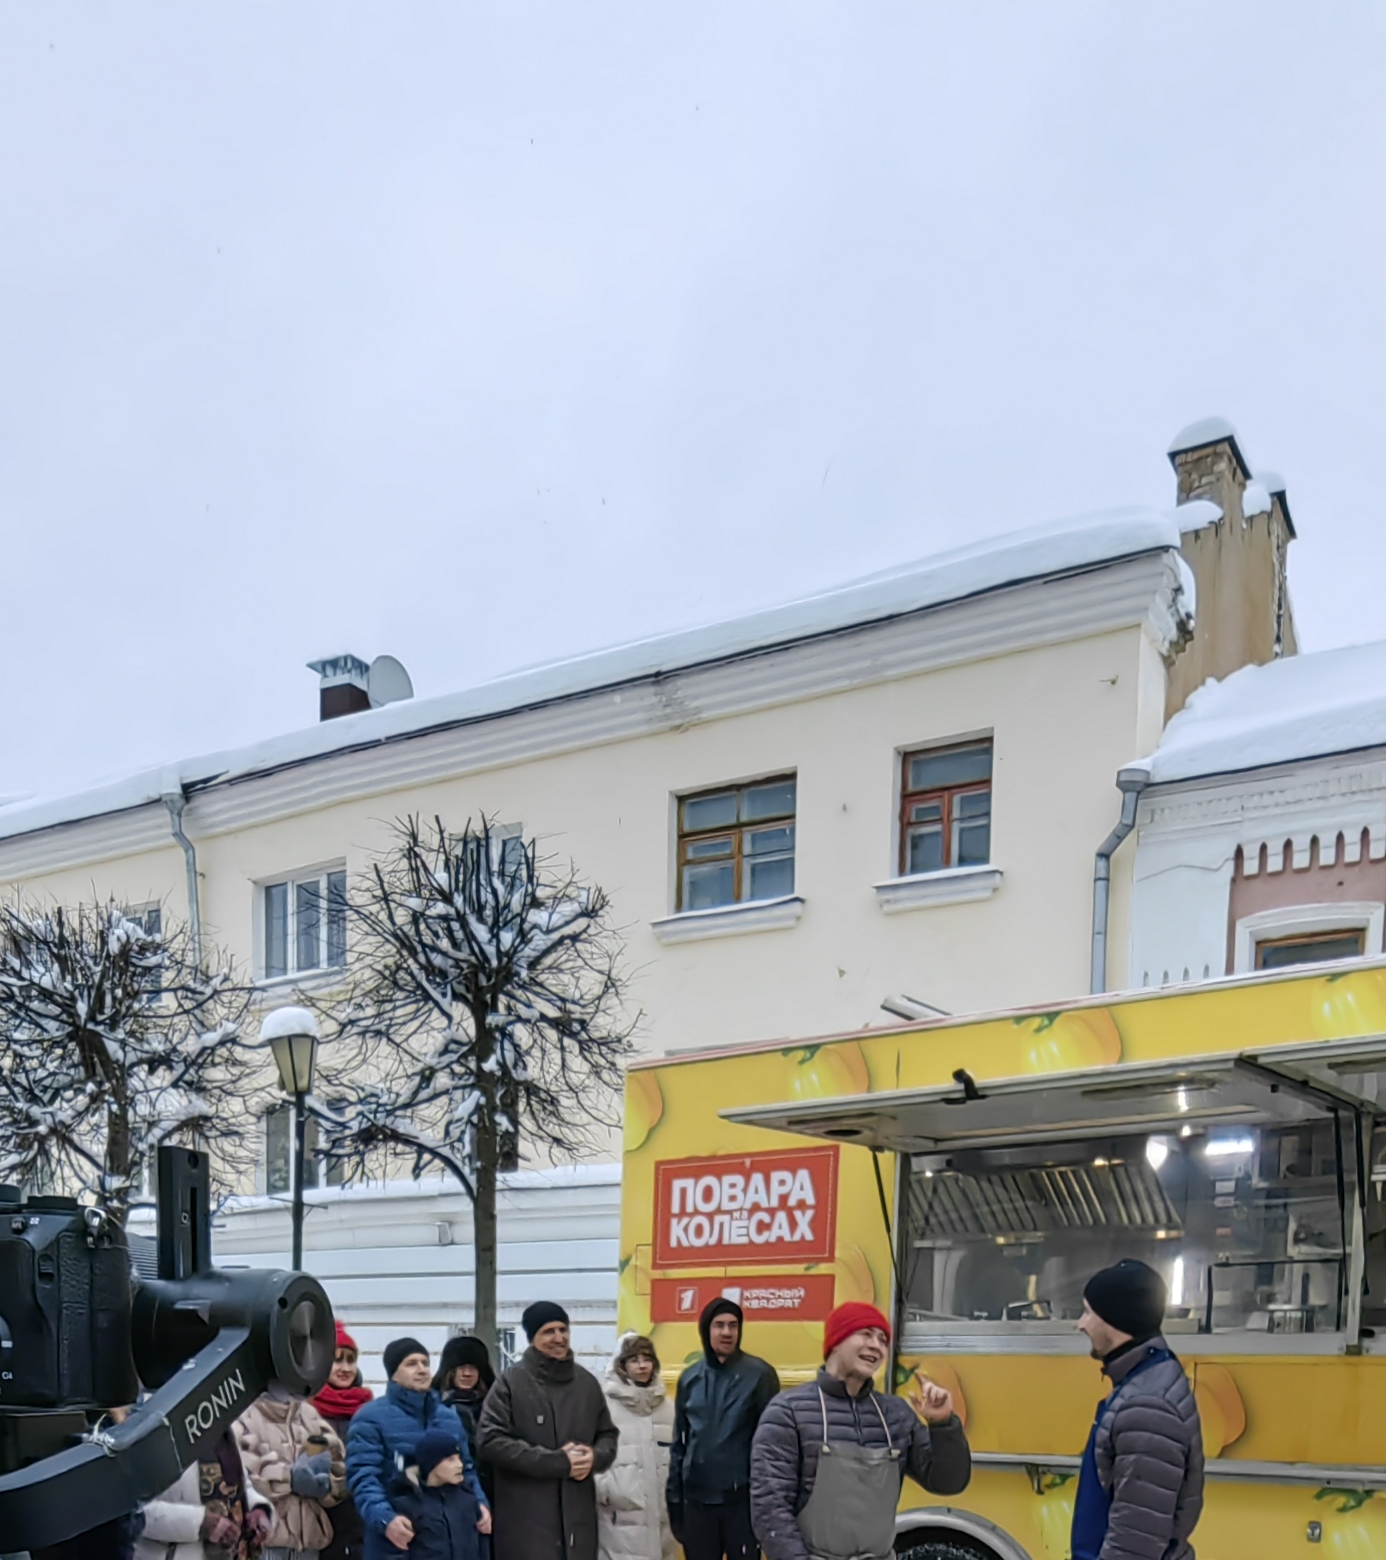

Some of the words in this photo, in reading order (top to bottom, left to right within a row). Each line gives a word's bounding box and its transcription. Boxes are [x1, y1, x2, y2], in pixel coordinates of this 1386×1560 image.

[671, 1169, 816, 1214] ПОВАРА
[669, 1209, 815, 1248] КОЛЕСАХ
[184, 1368, 247, 1445] RONIN
